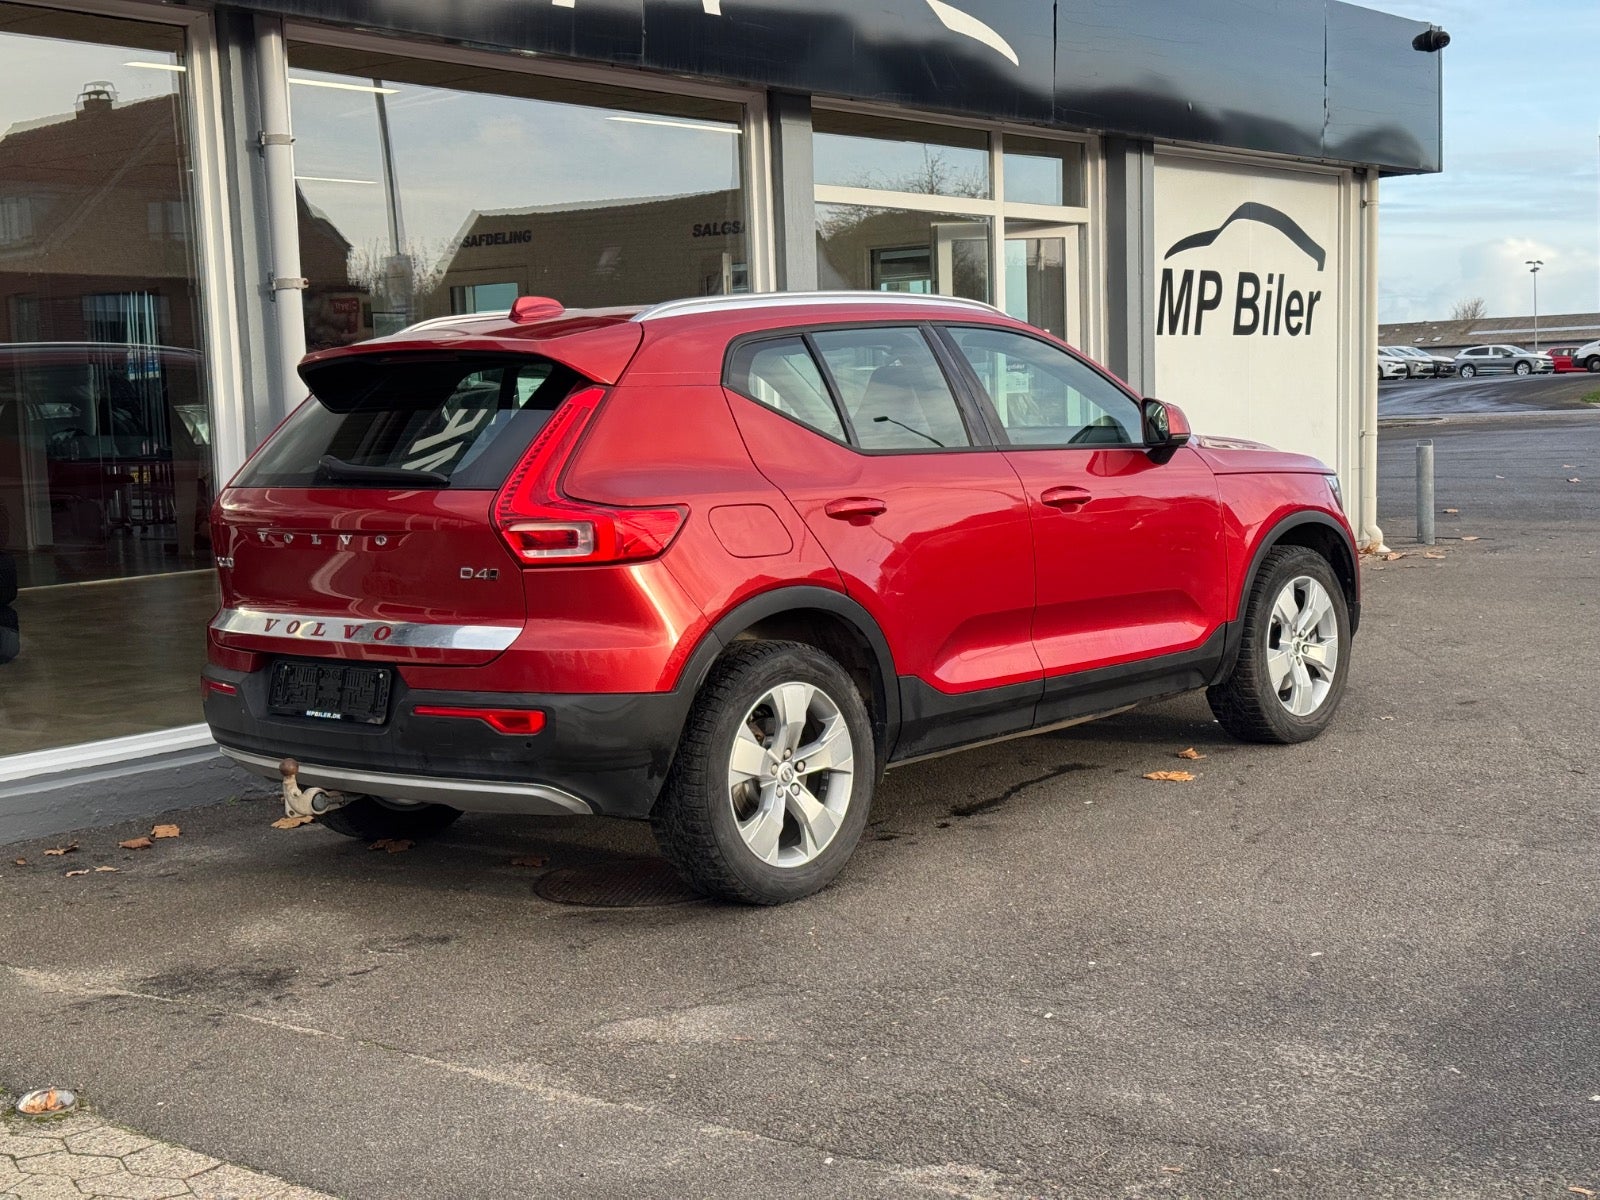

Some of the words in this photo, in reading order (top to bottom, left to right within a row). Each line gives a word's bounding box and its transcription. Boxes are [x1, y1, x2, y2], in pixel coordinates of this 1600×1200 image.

[1156, 268, 1223, 336] MP
[1232, 271, 1322, 337] Biler
[257, 531, 388, 546] VOLVO
[264, 618, 392, 641] VOLVO
